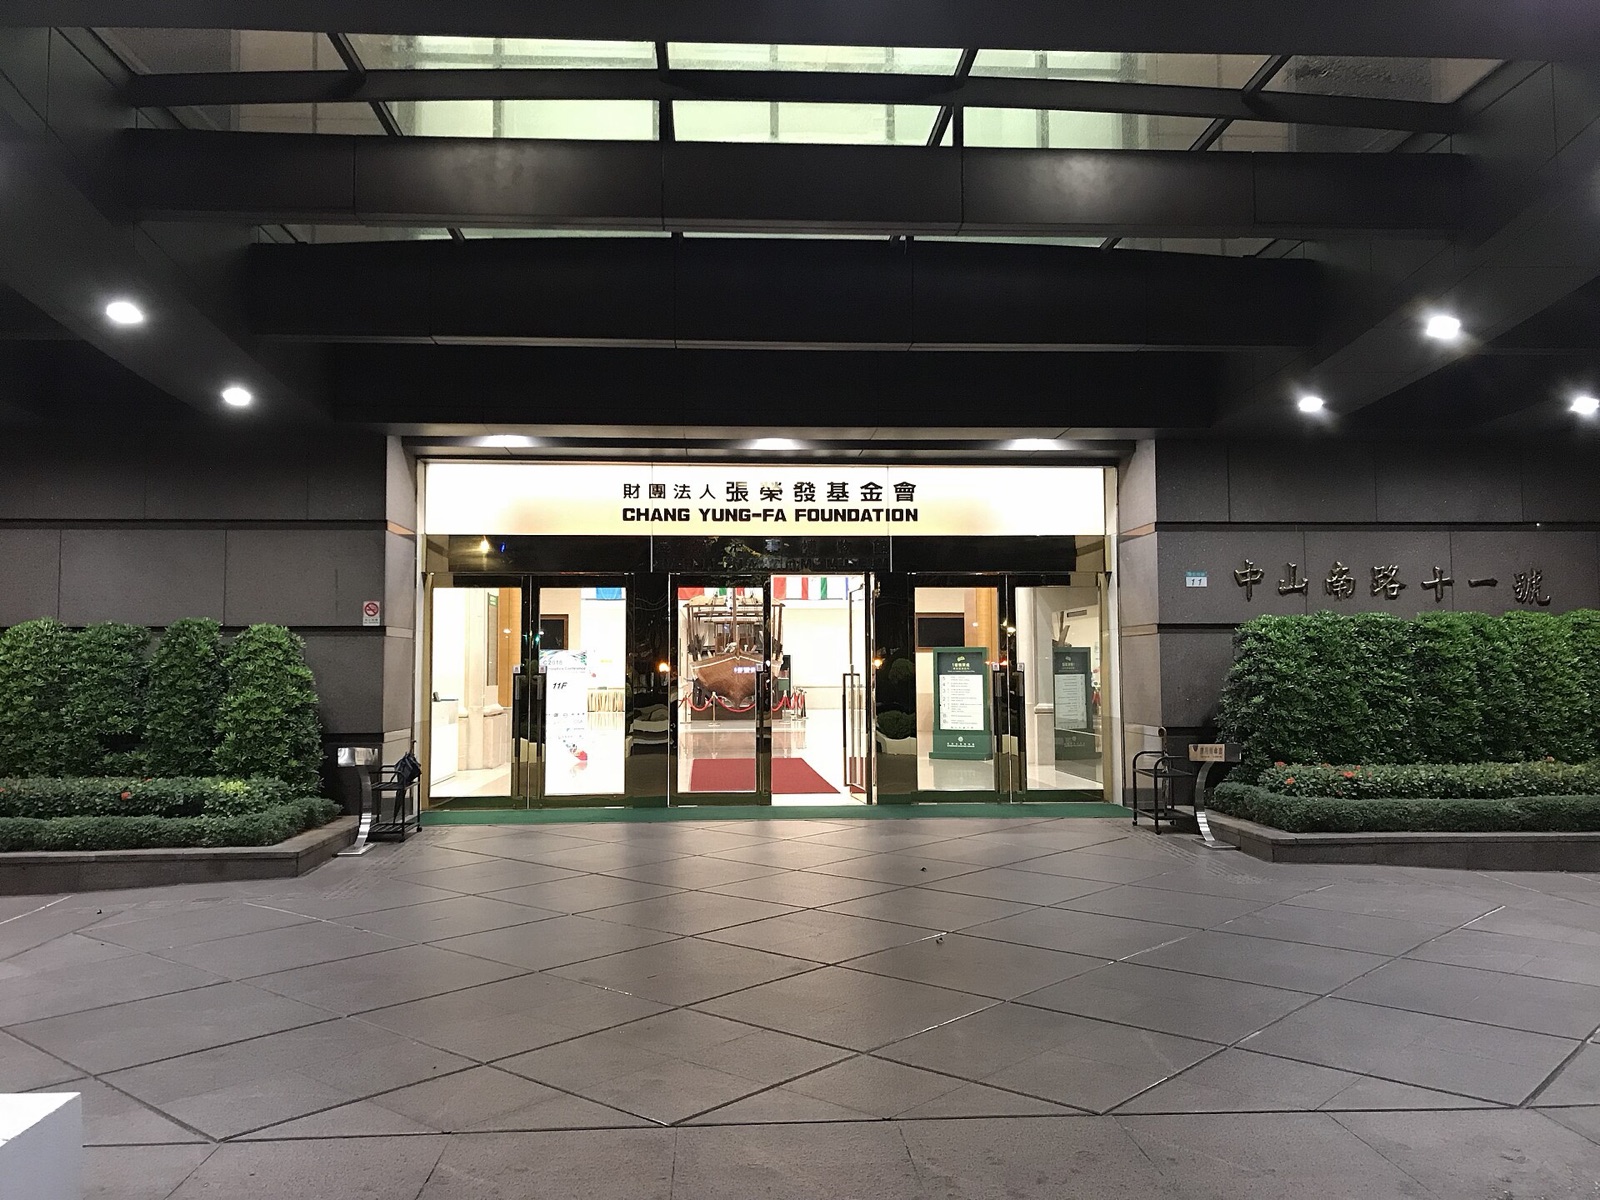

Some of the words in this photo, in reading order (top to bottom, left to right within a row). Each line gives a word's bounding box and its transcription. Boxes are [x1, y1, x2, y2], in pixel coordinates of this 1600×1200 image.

[623, 481, 917, 503] 財團法人張榮發基金會
[622, 508, 691, 522] CHANG
[698, 508, 788, 522] YUNG-FA
[794, 508, 919, 522] FOUNDATION
[1191, 578, 1202, 586] 11
[1233, 558, 1552, 607] 中山南路十一號
[553, 681, 568, 689] 11F
